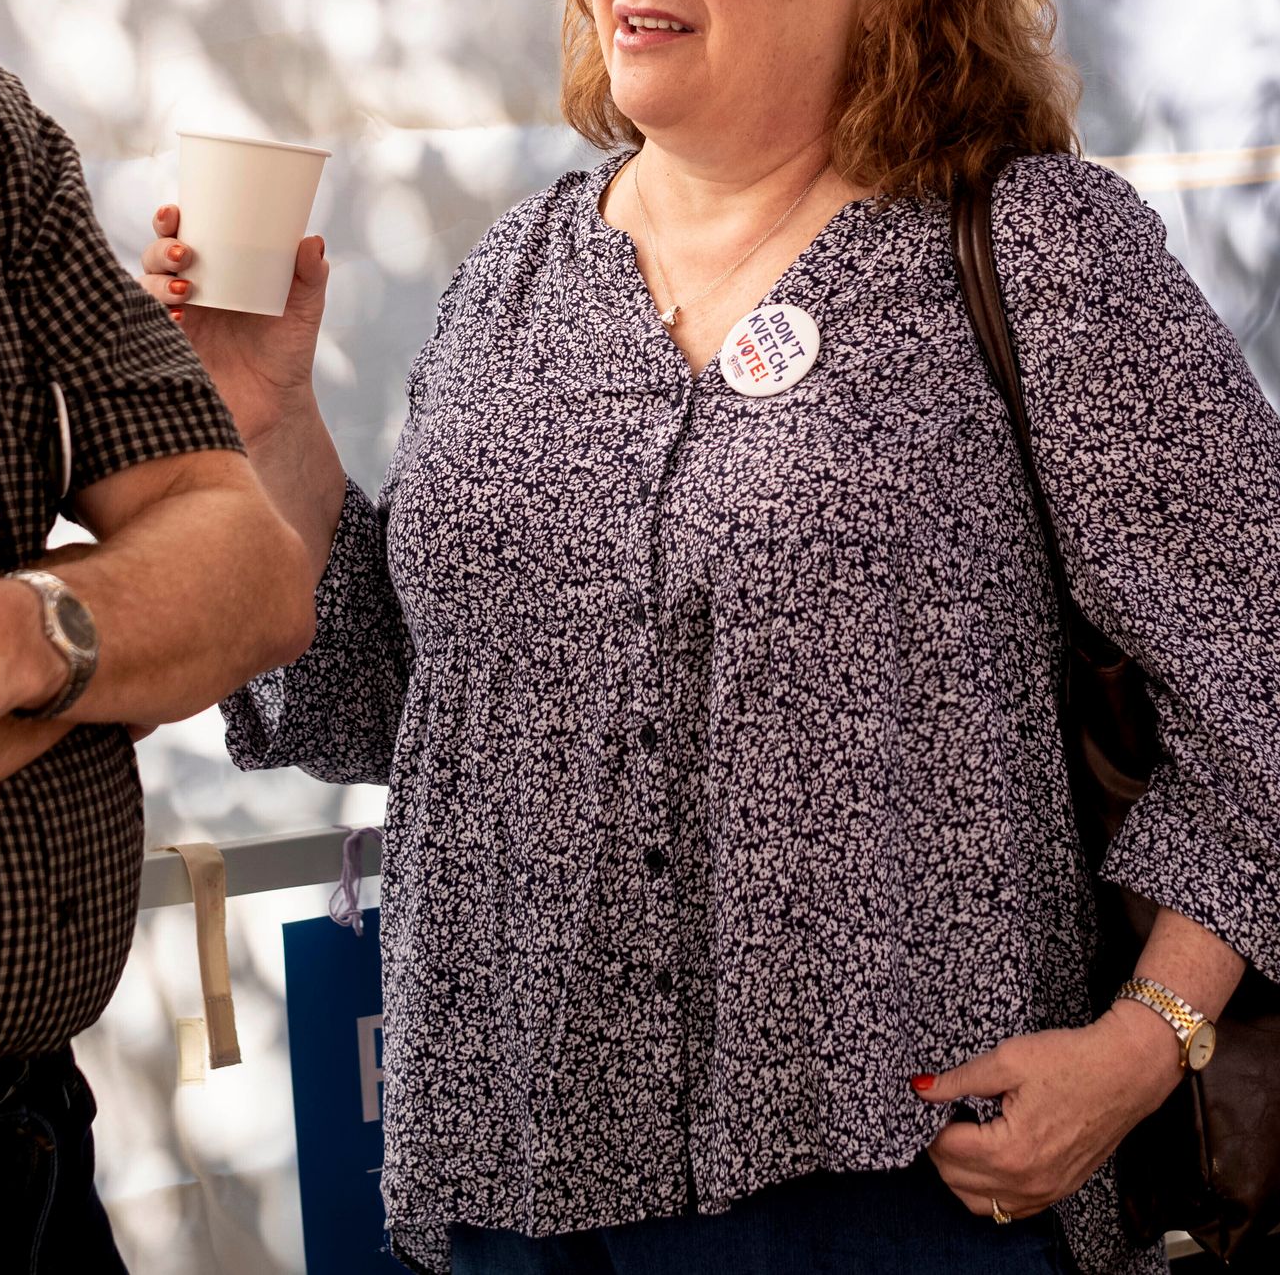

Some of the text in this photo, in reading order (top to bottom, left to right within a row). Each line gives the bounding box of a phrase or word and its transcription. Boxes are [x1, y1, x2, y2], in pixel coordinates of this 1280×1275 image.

[736, 333, 769, 382] VOTE!
[748, 314, 789, 382] KVETCH,
[769, 311, 805, 359] DON'T
